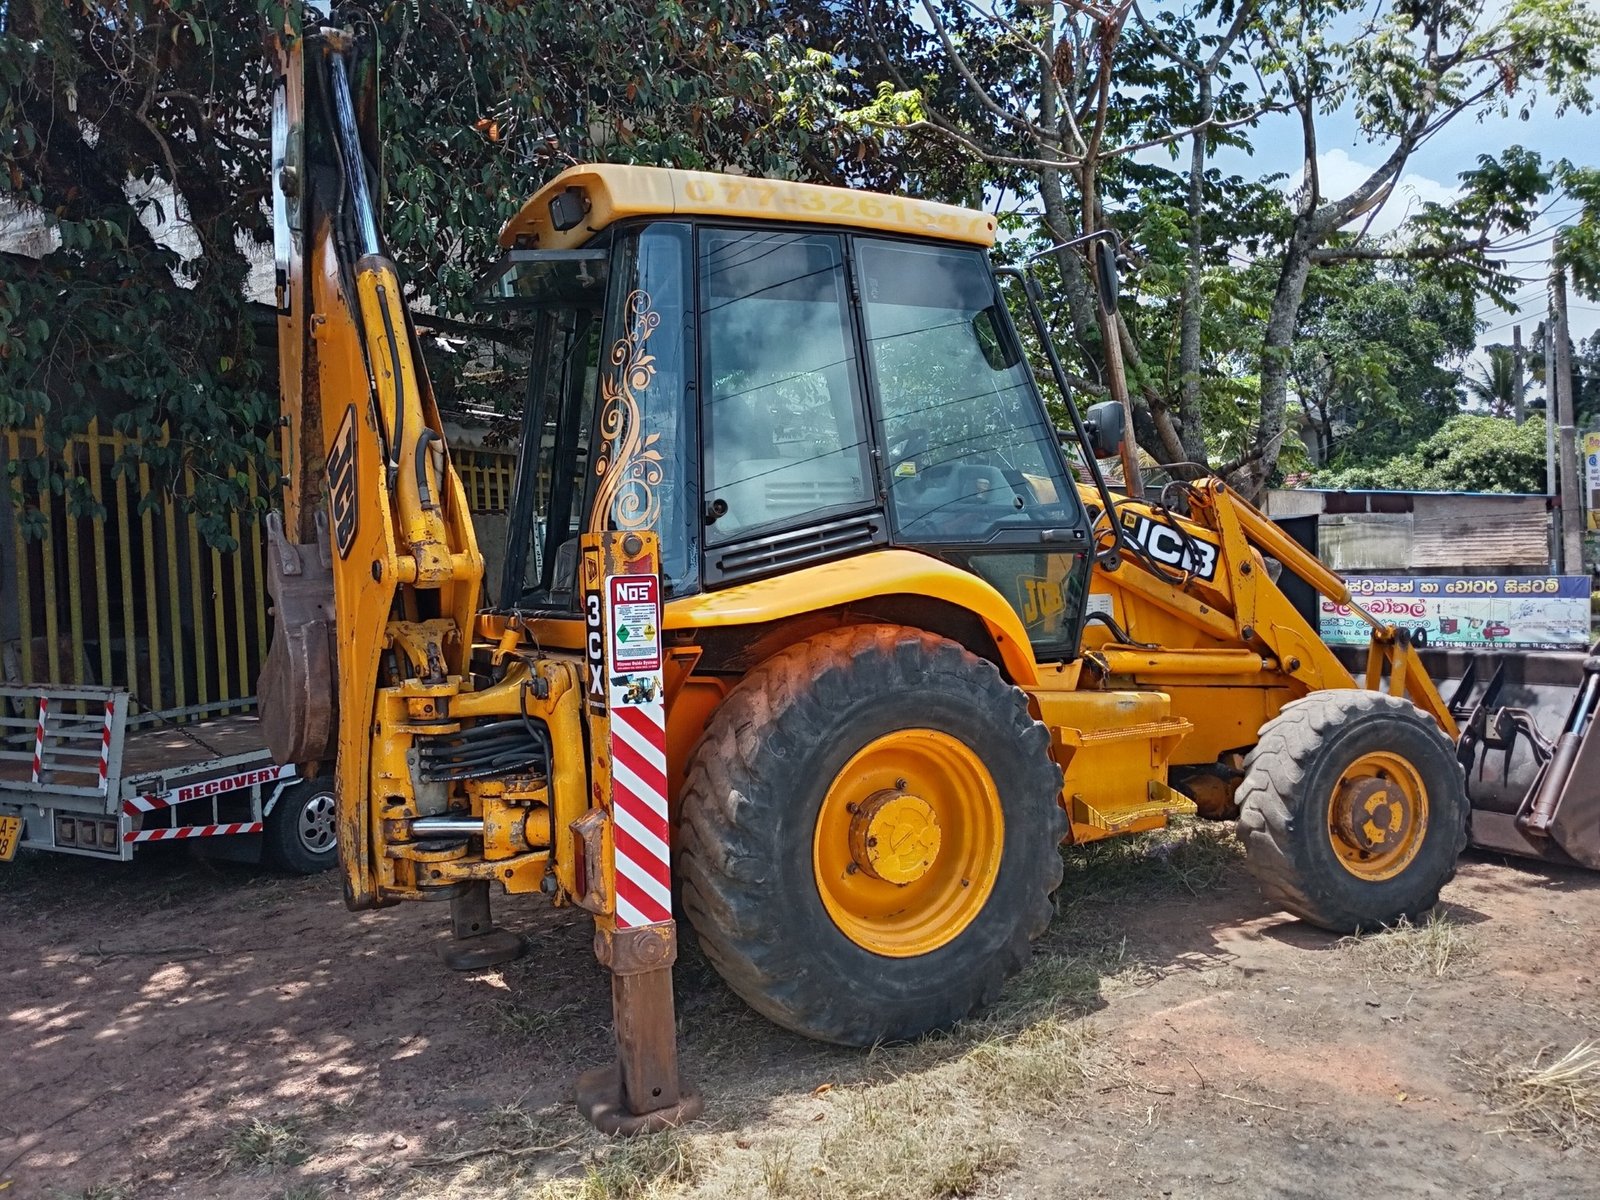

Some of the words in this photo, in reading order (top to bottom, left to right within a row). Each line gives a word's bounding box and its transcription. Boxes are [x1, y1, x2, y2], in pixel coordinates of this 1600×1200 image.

[1121, 517, 1216, 577] JCB
[1024, 580, 1064, 624] JCB
[1420, 582, 1439, 593] හා
[178, 766, 281, 801] RECOVERY
